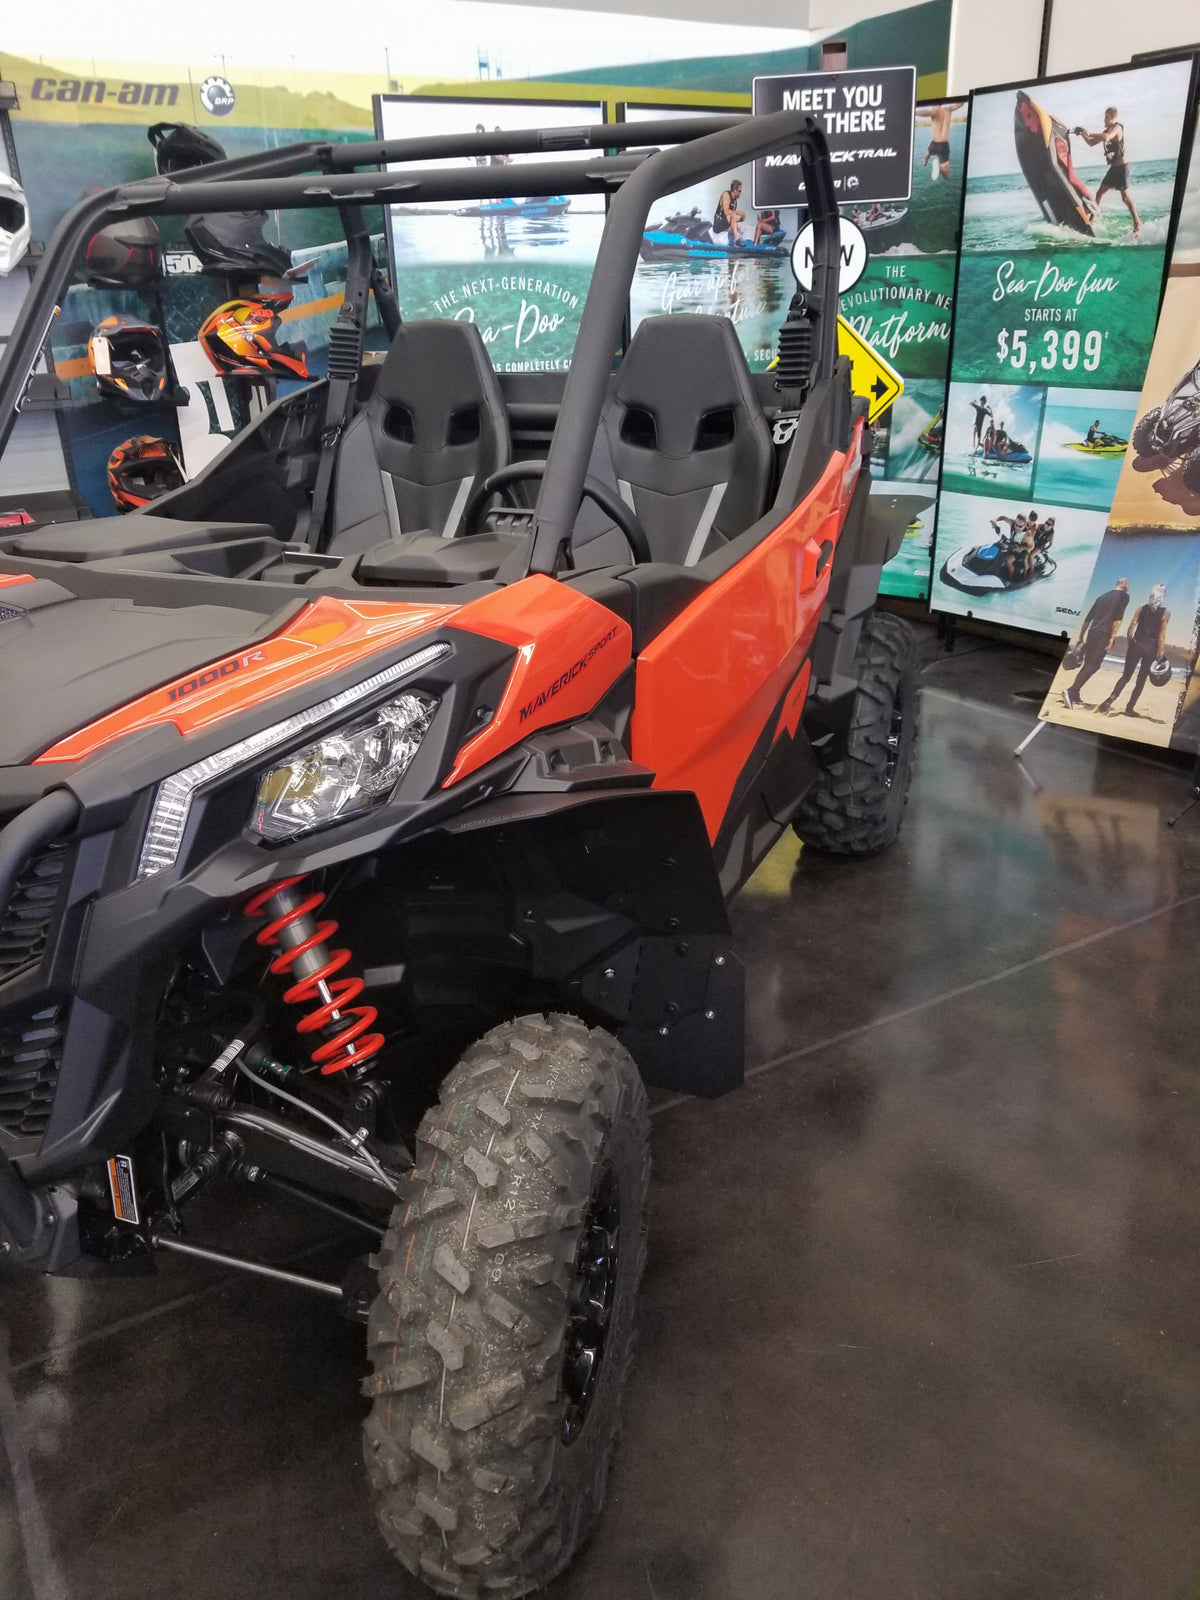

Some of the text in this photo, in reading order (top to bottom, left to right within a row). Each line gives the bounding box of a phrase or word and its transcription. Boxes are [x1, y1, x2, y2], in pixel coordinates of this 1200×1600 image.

[31, 77, 179, 106] can-am
[782, 84, 883, 111] MEET YOU
[823, 109, 886, 134] THERE
[857, 148, 897, 159] TRAIL
[804, 244, 855, 269] NW
[885, 265, 907, 278] THE
[992, 260, 1120, 305] Sea-Doo fun
[432, 276, 580, 313] THE NEXT-GENERATION
[840, 286, 952, 312] EVOLUTIONARY NE
[1024, 308, 1078, 322] STARTS AT
[505, 359, 560, 373] COMPLETELY
[754, 349, 778, 361] SECU
[168, 650, 267, 702] 1000R
[519, 625, 618, 723] MAVERICK SPORT
